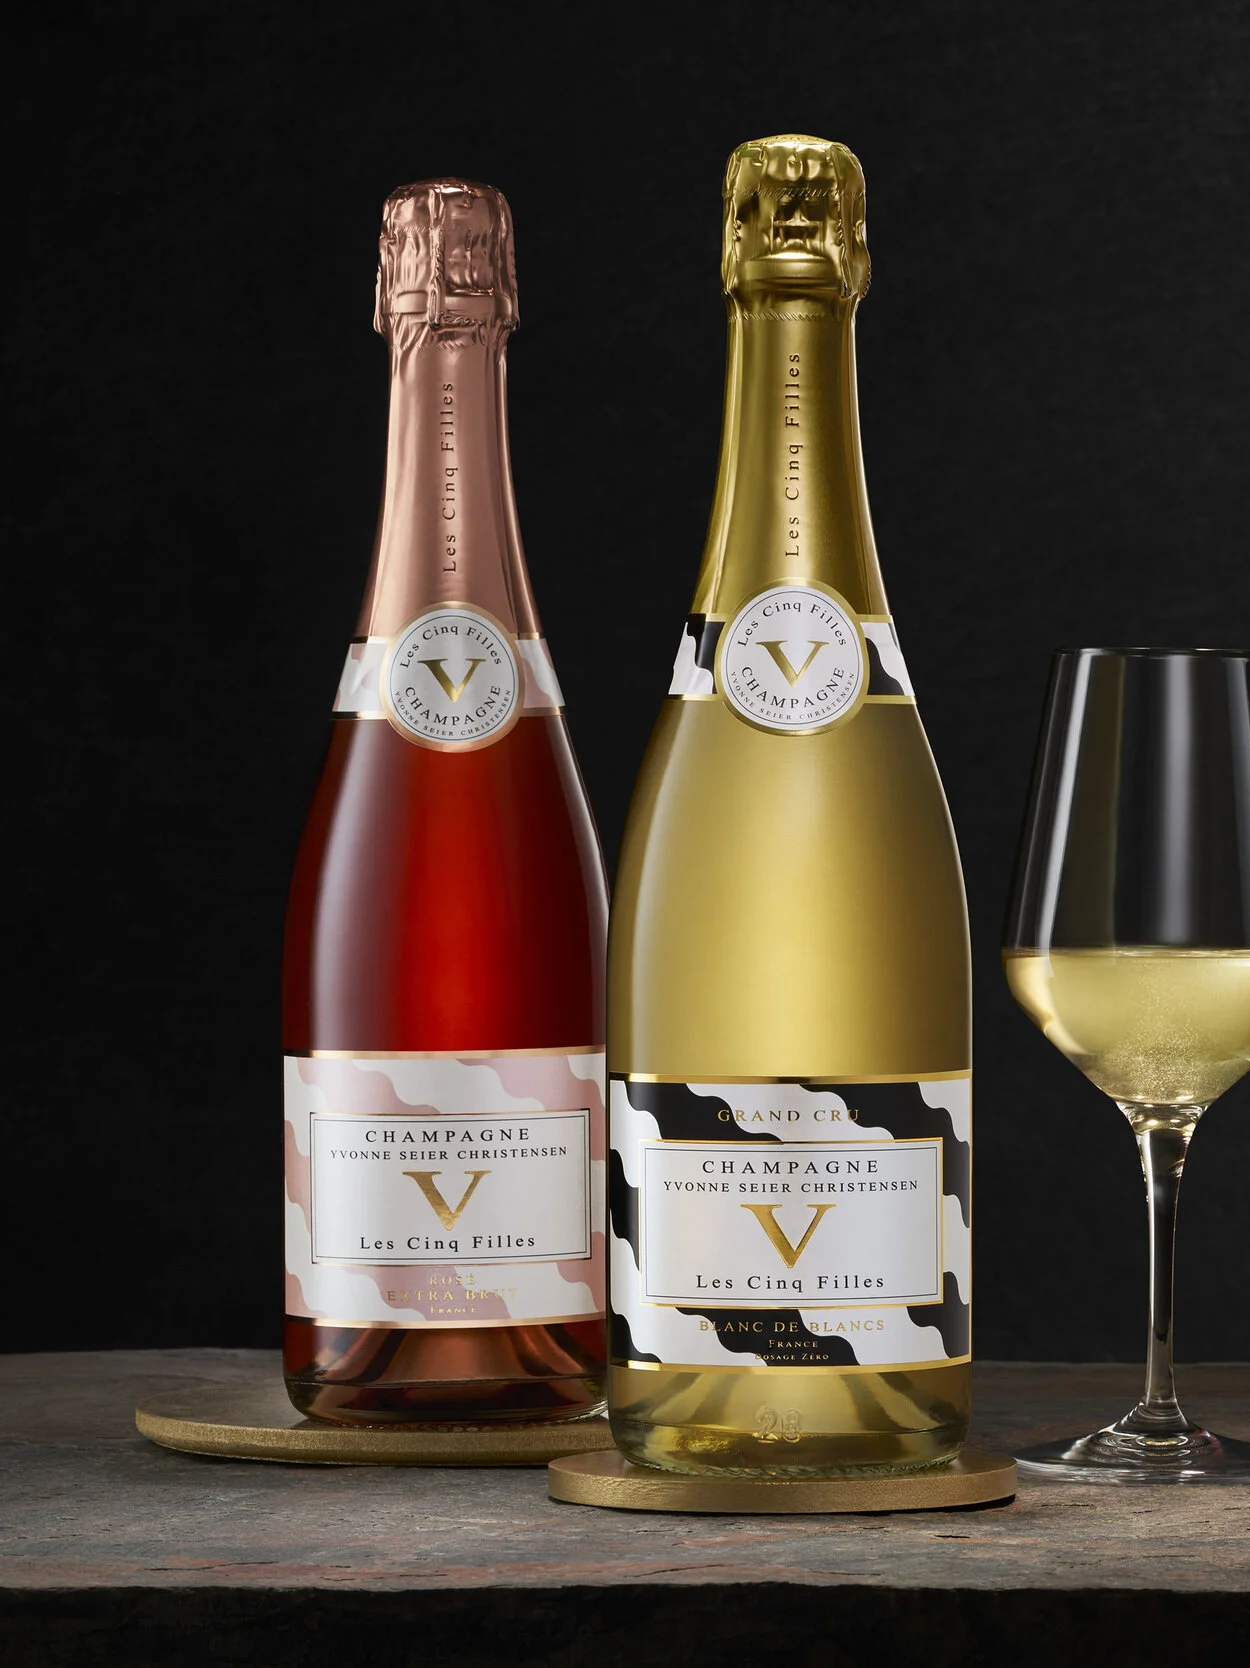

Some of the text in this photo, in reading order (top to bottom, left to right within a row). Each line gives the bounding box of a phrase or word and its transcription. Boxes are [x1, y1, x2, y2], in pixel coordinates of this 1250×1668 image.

[785, 354, 803, 556] Les Cinq Filles
[440, 383, 458, 572] Les Cinq Filles
[738, 601, 847, 646] Les Cinq Filles
[400, 625, 502, 668] Les Cinq Filles
[756, 641, 830, 687] V
[417, 658, 486, 703] V
[731, 671, 854, 720] YVONNE SEIER CHRISTENSEN
[741, 666, 845, 709] CHAMPAGNE
[395, 689, 511, 736] YVONNE SEIER CHRISTENSEN
[405, 685, 501, 726] CHAMPAGNE
[365, 1128, 530, 1144] CHAMPAGNE
[717, 1109, 860, 1122] GRAND CRU
[330, 1146, 568, 1161] YVONNE SEIER CHRISTENSEN
[702, 1160, 879, 1175] CHAMPAGNE
[402, 1170, 492, 1231] V
[663, 1180, 919, 1193] YVONNE SEIER CHRISTENSEN
[360, 1235, 536, 1252] Les Cinq Filles
[740, 1204, 837, 1269] V
[387, 1290, 454, 1301] EXTRA
[429, 1273, 475, 1286] ROSÉ
[696, 1274, 885, 1292] Les Cinq Filles
[699, 1320, 885, 1332] BLANC DE BLANCS
